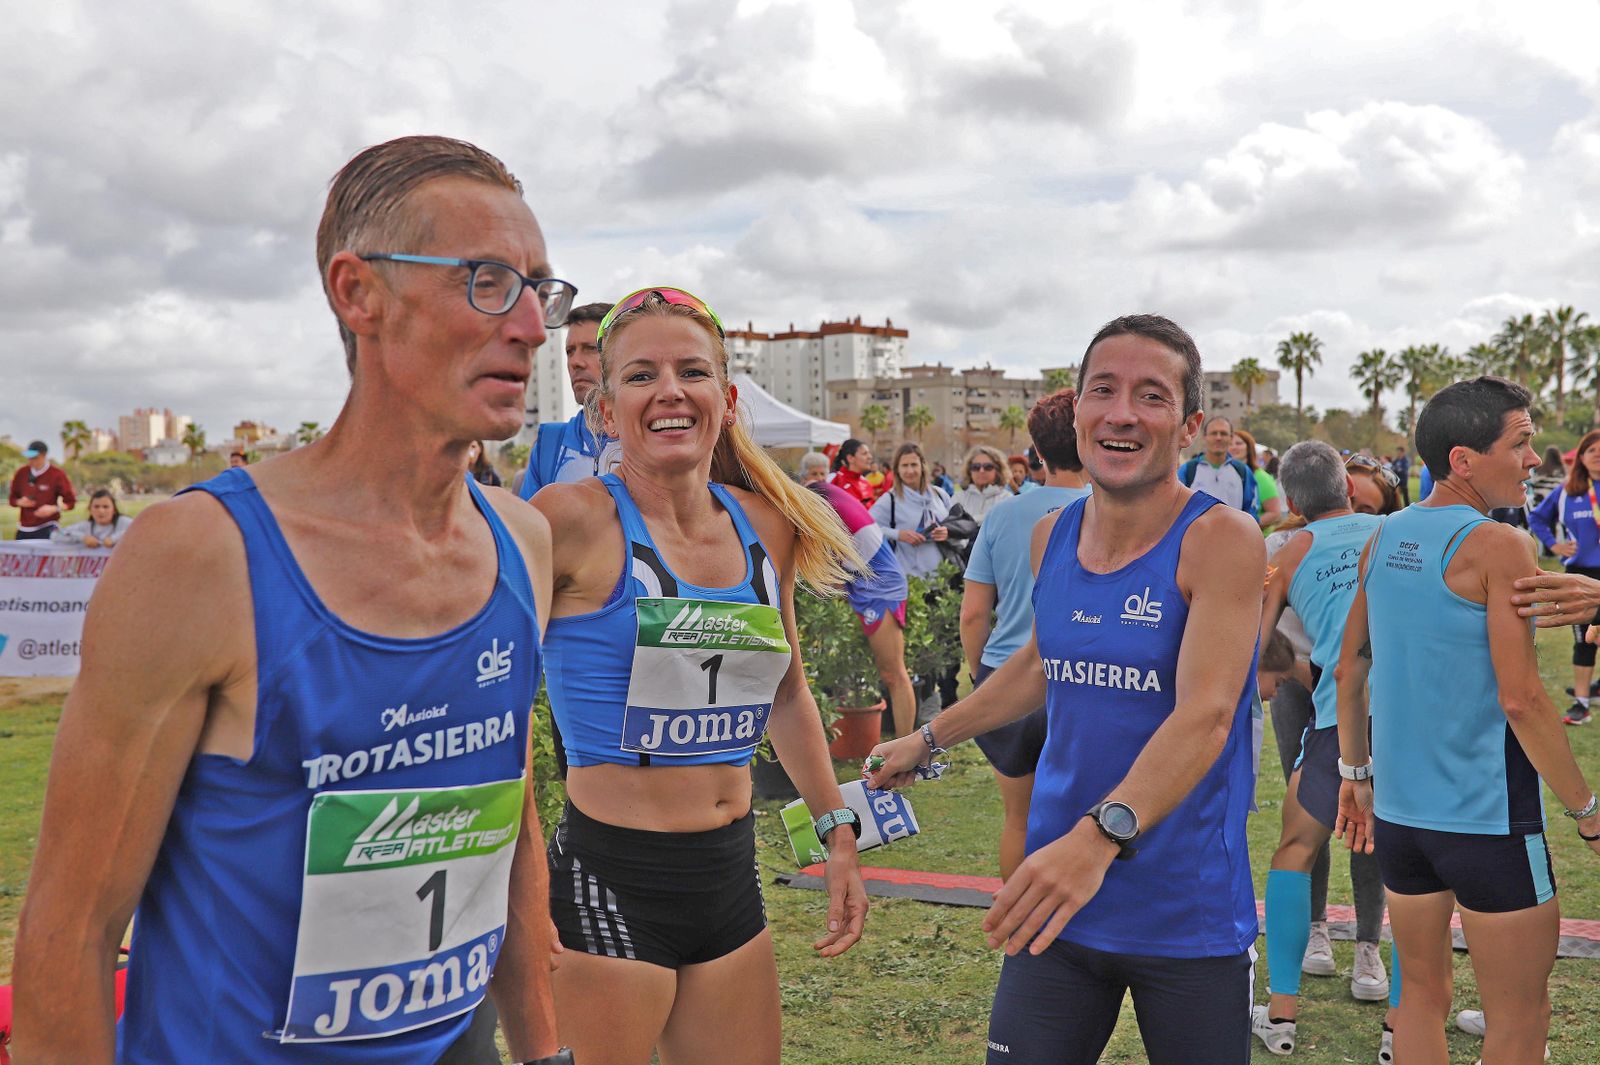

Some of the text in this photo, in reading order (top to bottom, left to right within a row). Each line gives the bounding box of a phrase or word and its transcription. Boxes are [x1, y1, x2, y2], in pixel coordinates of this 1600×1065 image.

[1316, 562, 1358, 582] Estamo
[666, 602, 748, 633] Master
[667, 631, 777, 648] RFEA ATLETISMO
[700, 654, 724, 704] 1
[1041, 658, 1162, 692] OTASIERRA
[302, 710, 516, 789] TROTASIERRA
[353, 796, 481, 844] Master
[356, 822, 514, 860] RFEA ATLETISMO
[415, 869, 448, 952] 1
